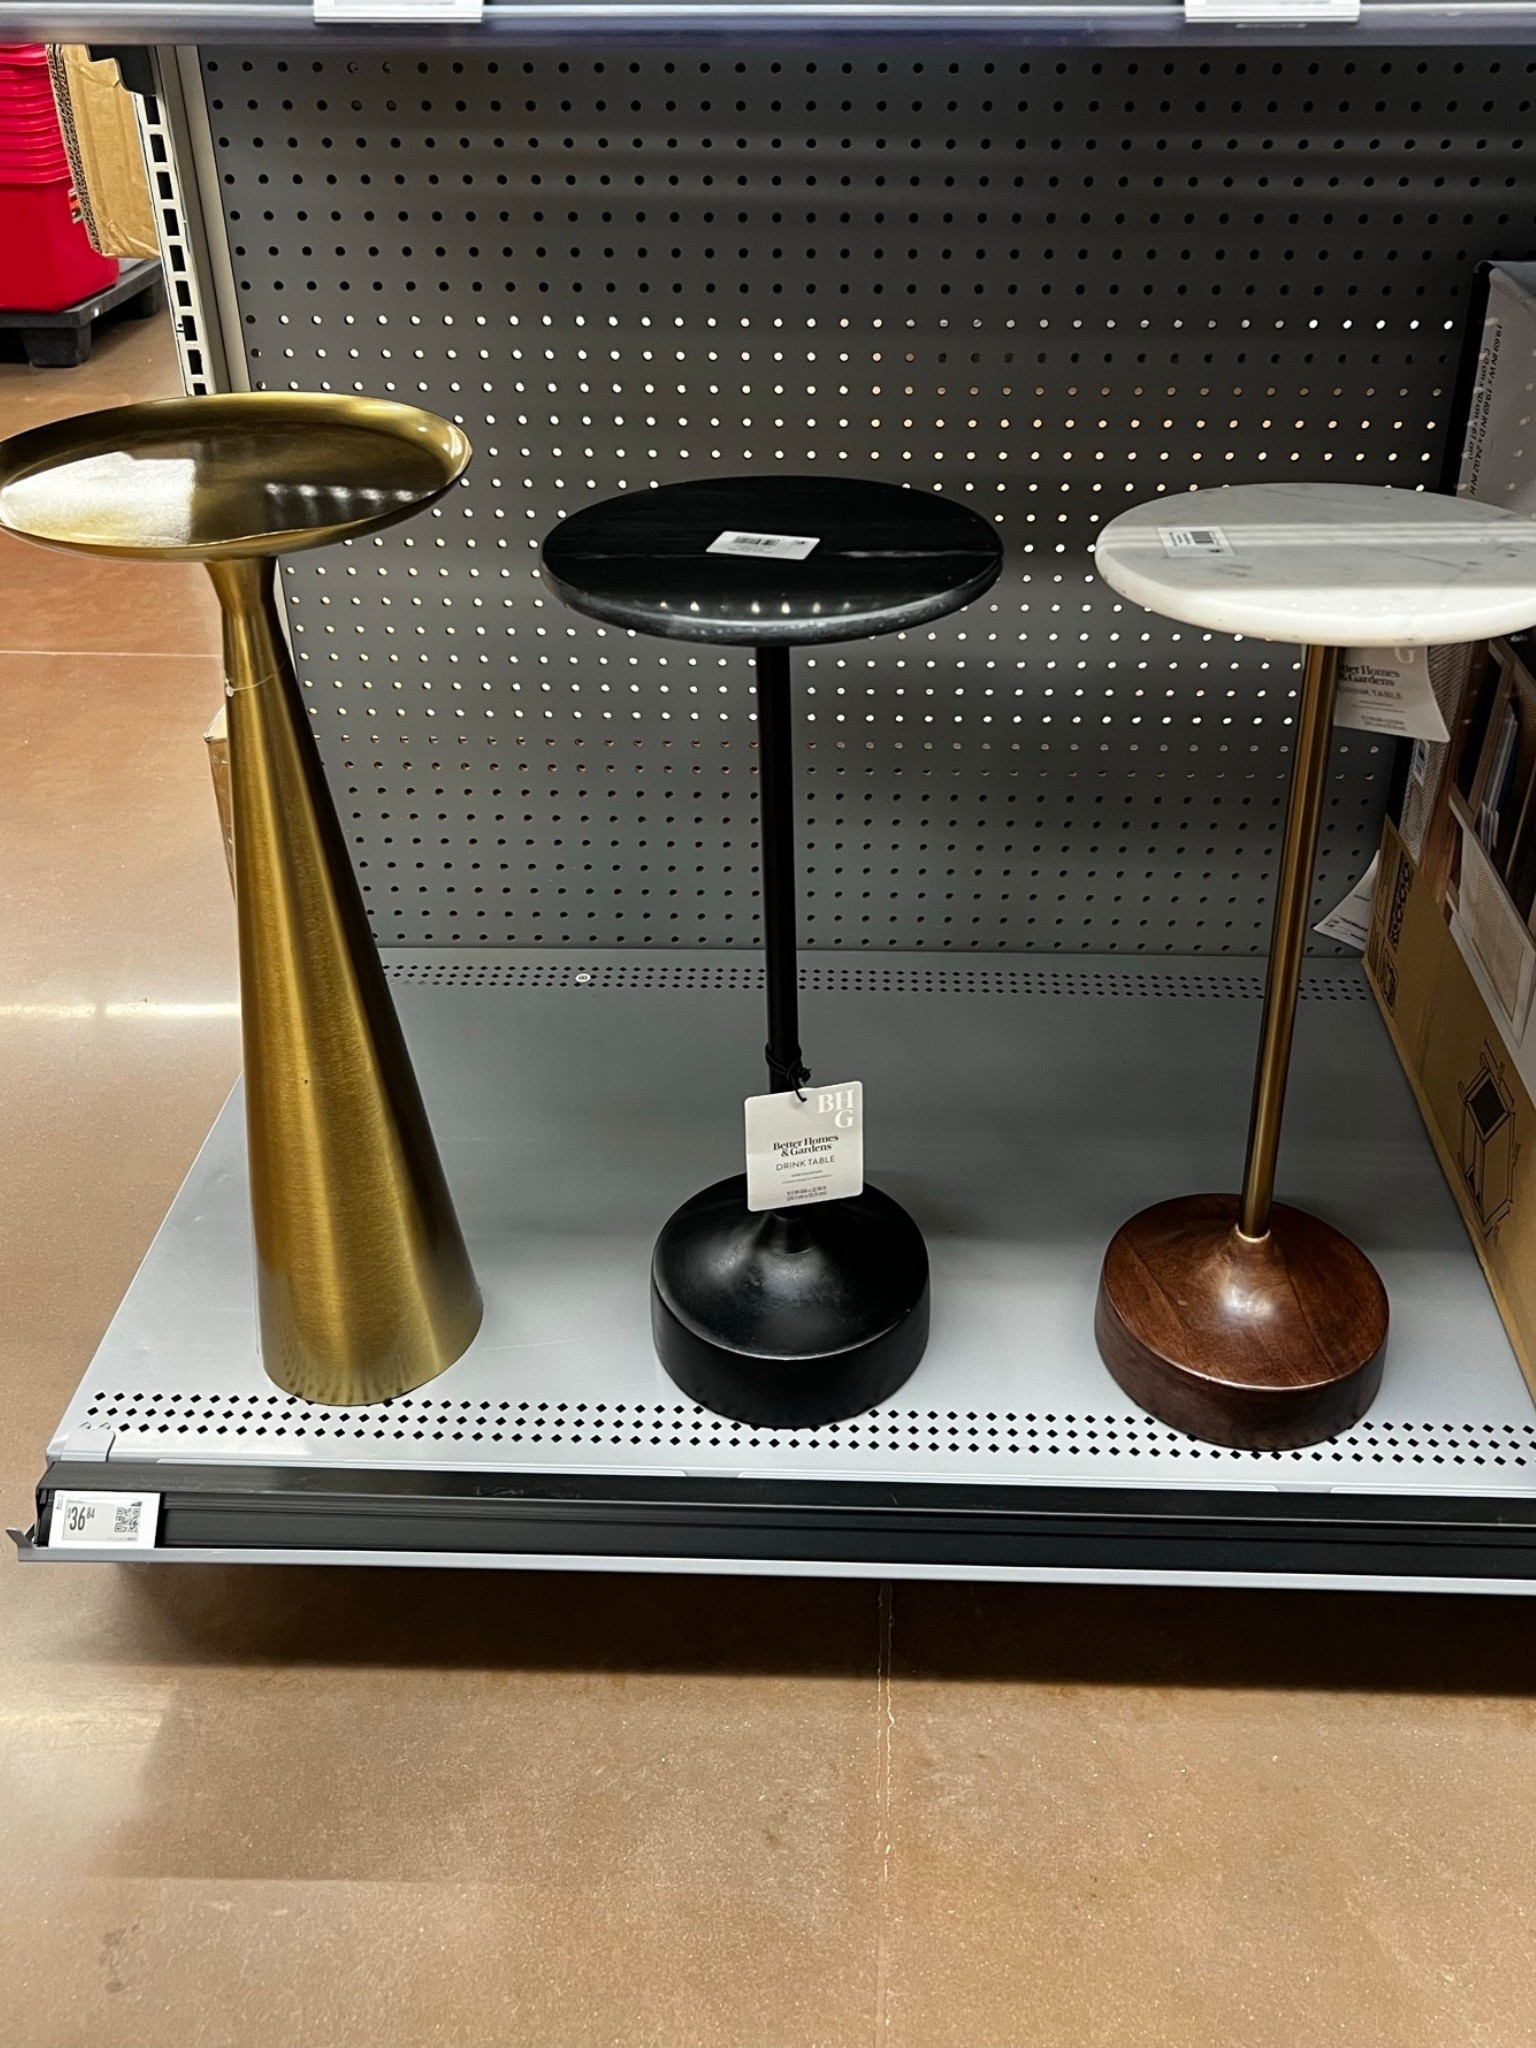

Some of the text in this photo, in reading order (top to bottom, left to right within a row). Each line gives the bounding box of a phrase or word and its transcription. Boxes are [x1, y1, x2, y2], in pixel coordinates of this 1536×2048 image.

[1361, 665, 1400, 678] Homes
[1348, 673, 1395, 686] Gardens
[834, 1109, 854, 1128] G
[773, 1135, 839, 1151] Better Homes
[781, 1143, 832, 1157] & Gardens
[776, 1155, 835, 1171] DRINK TABLE
